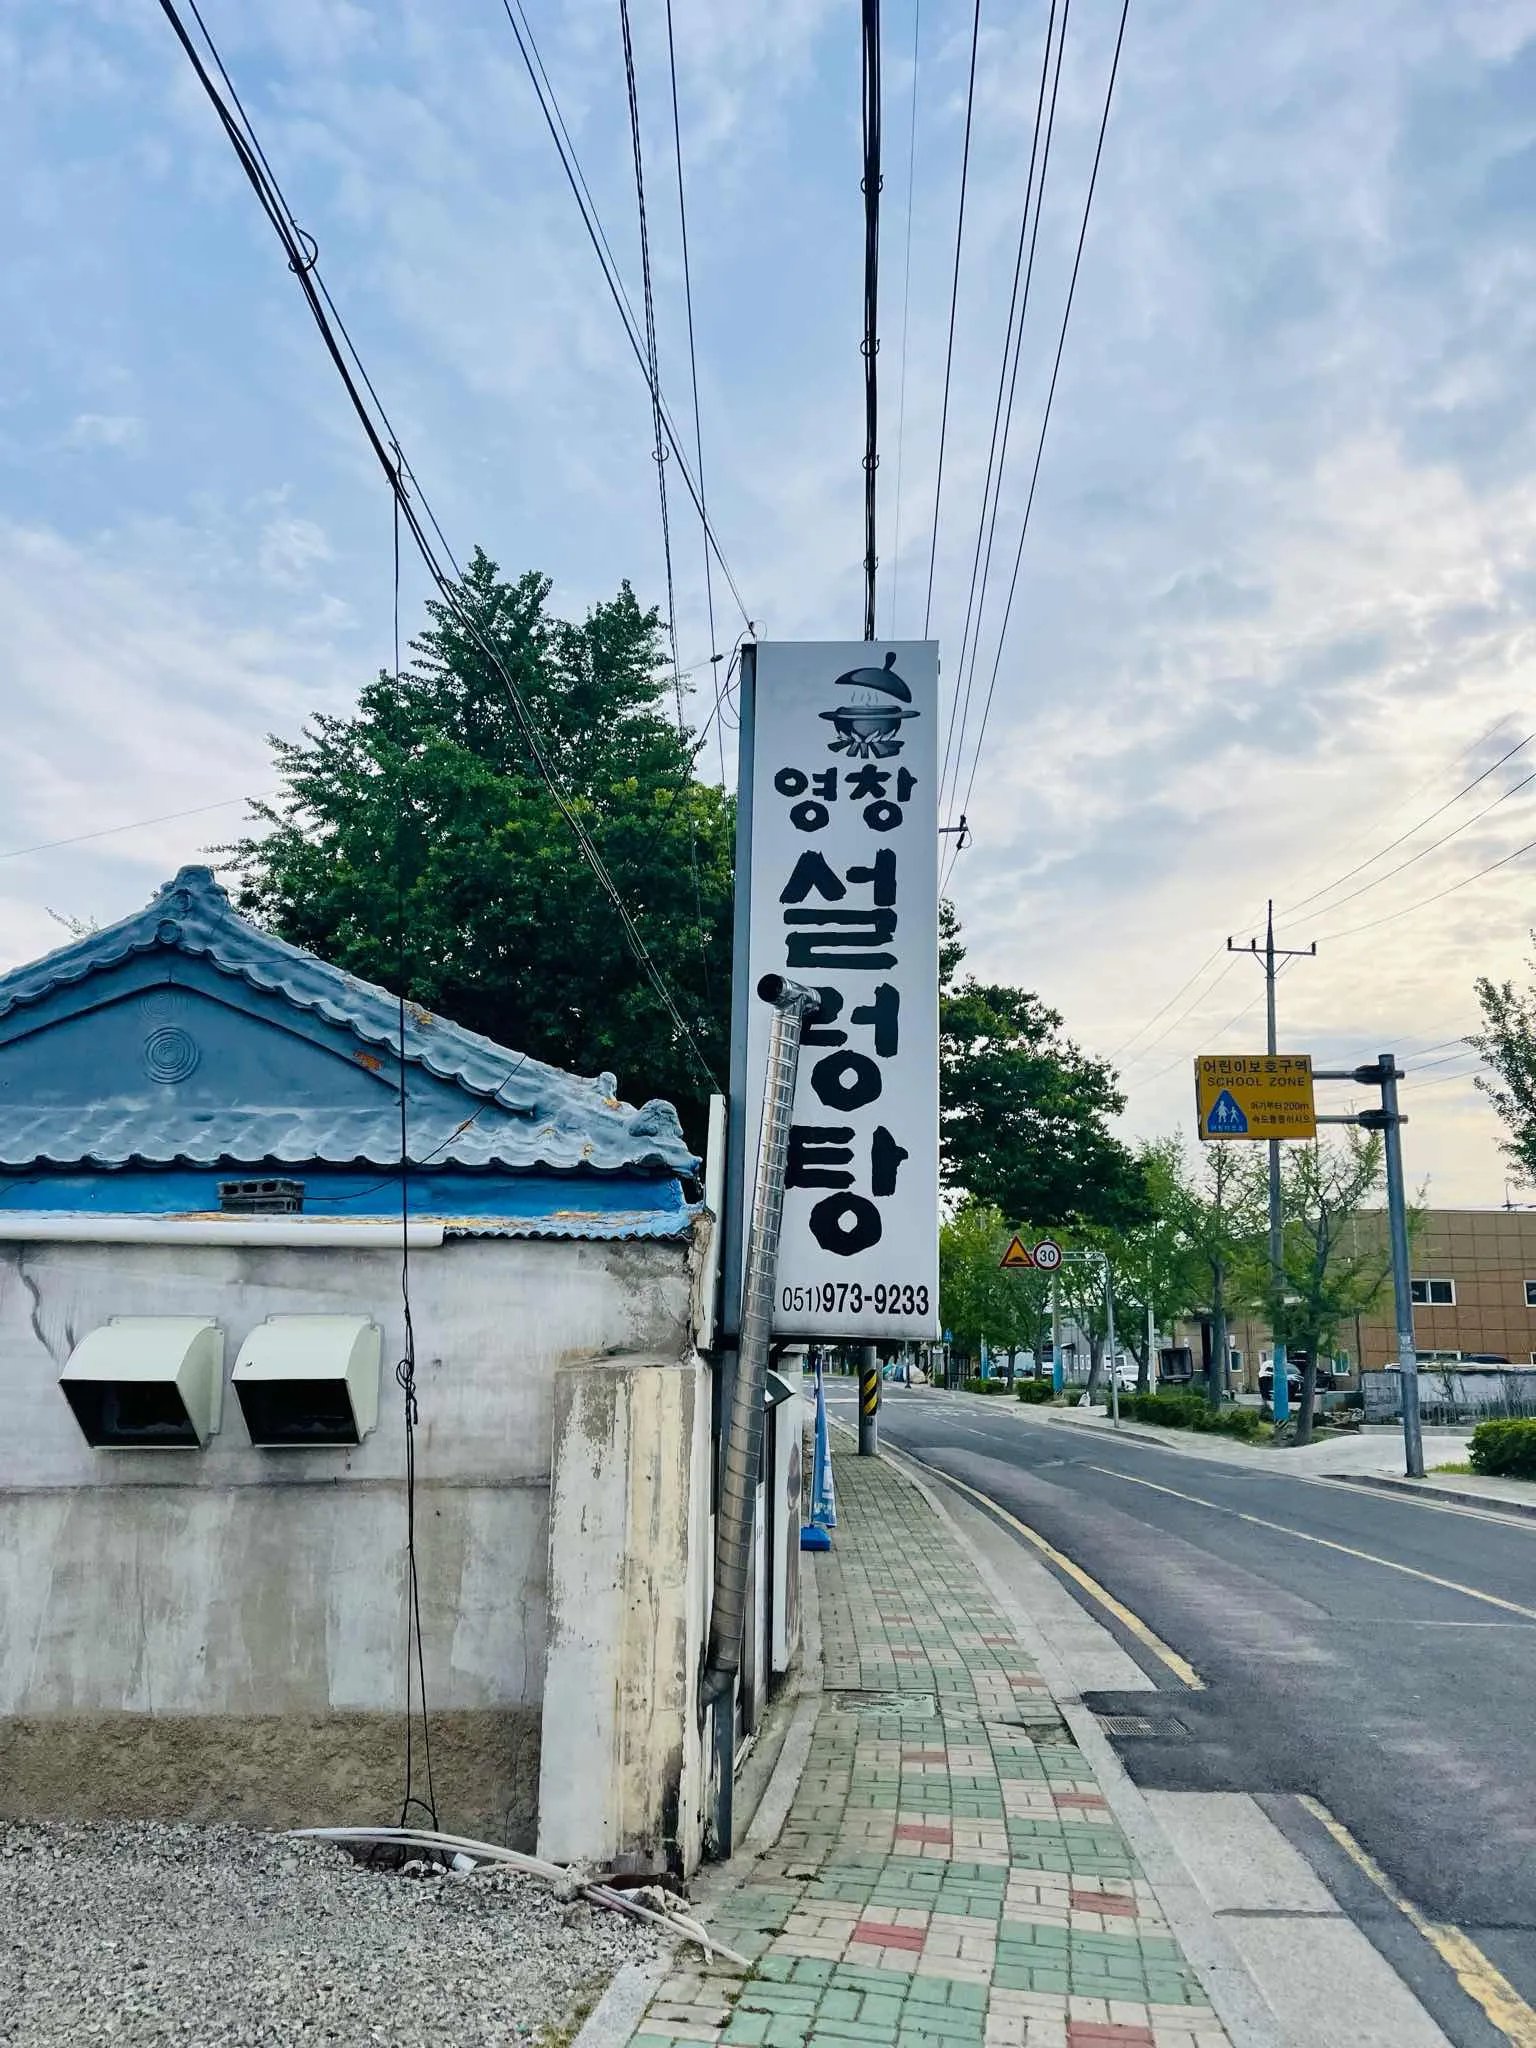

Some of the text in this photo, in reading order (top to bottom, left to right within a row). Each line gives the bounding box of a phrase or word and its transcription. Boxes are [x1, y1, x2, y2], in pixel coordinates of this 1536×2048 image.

[774, 764, 918, 832] 영창
[779, 849, 909, 1257] 설렁탕
[1203, 1059, 1307, 1073] 어린이보호구역
[1207, 1077, 1305, 1087] SCHOOL ZONE
[1039, 1249, 1056, 1263] 30
